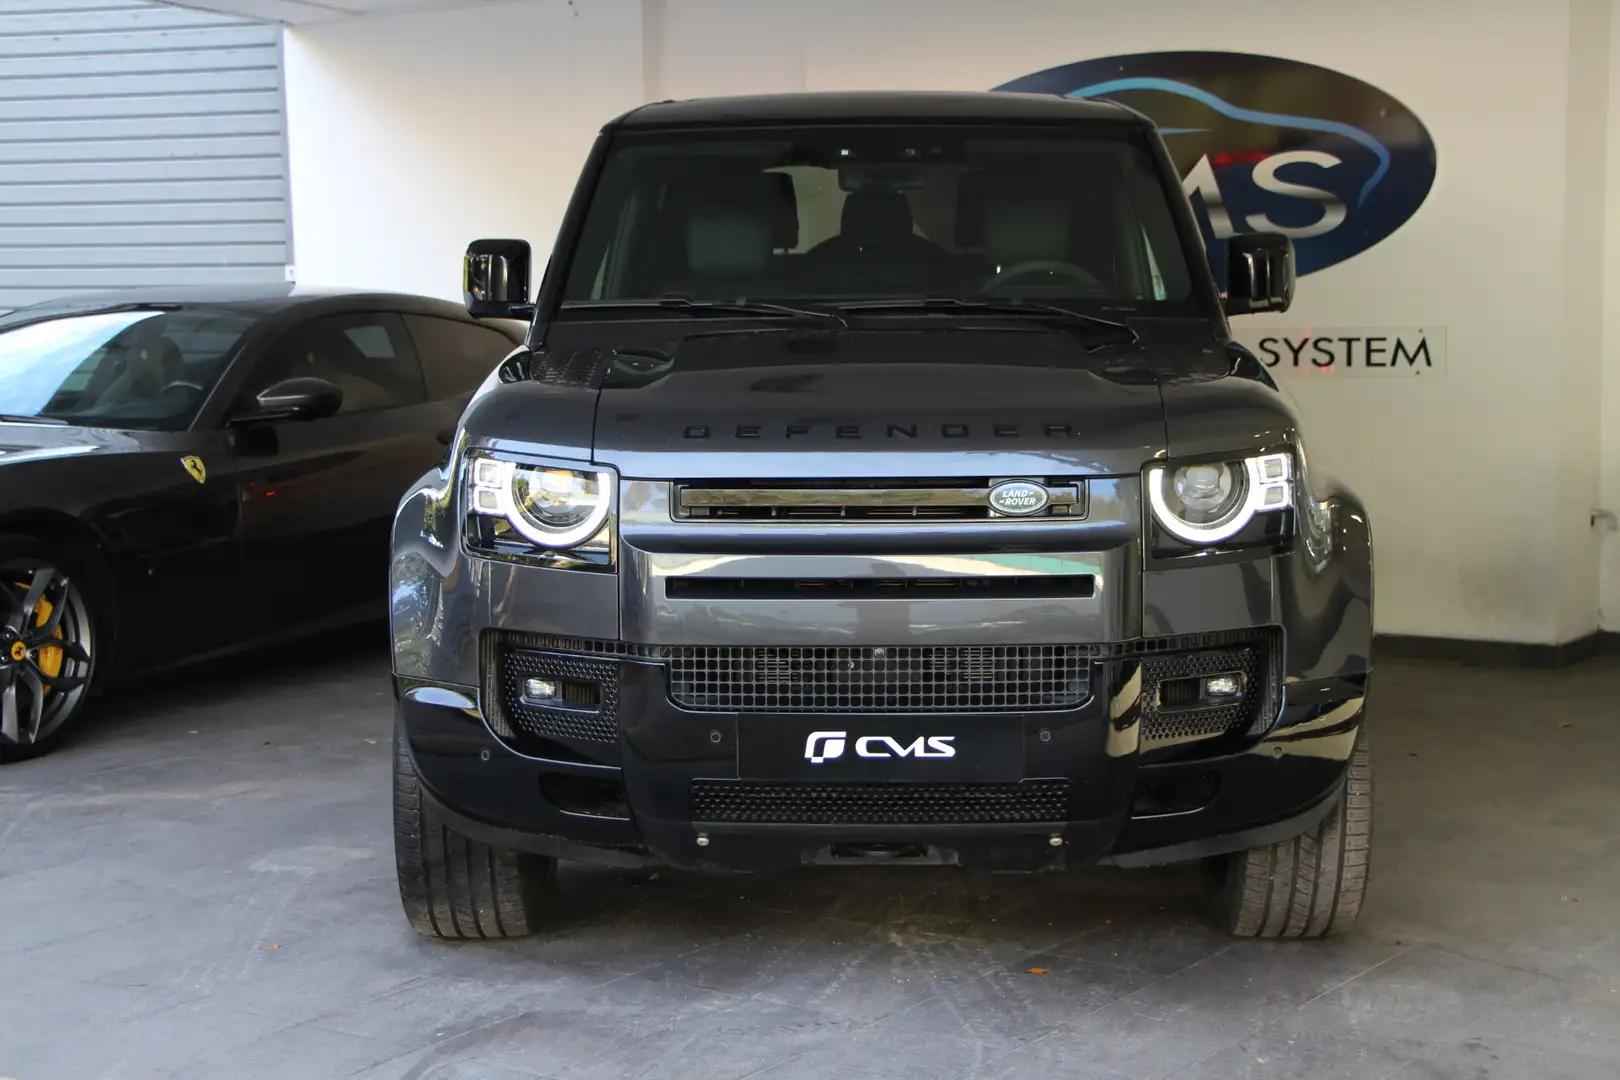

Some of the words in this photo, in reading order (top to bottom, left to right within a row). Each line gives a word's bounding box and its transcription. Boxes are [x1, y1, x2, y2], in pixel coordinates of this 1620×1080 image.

[1258, 337, 1432, 367] SYSTEM
[683, 424, 1073, 439] DEFENDER
[855, 736, 956, 758] CMS
